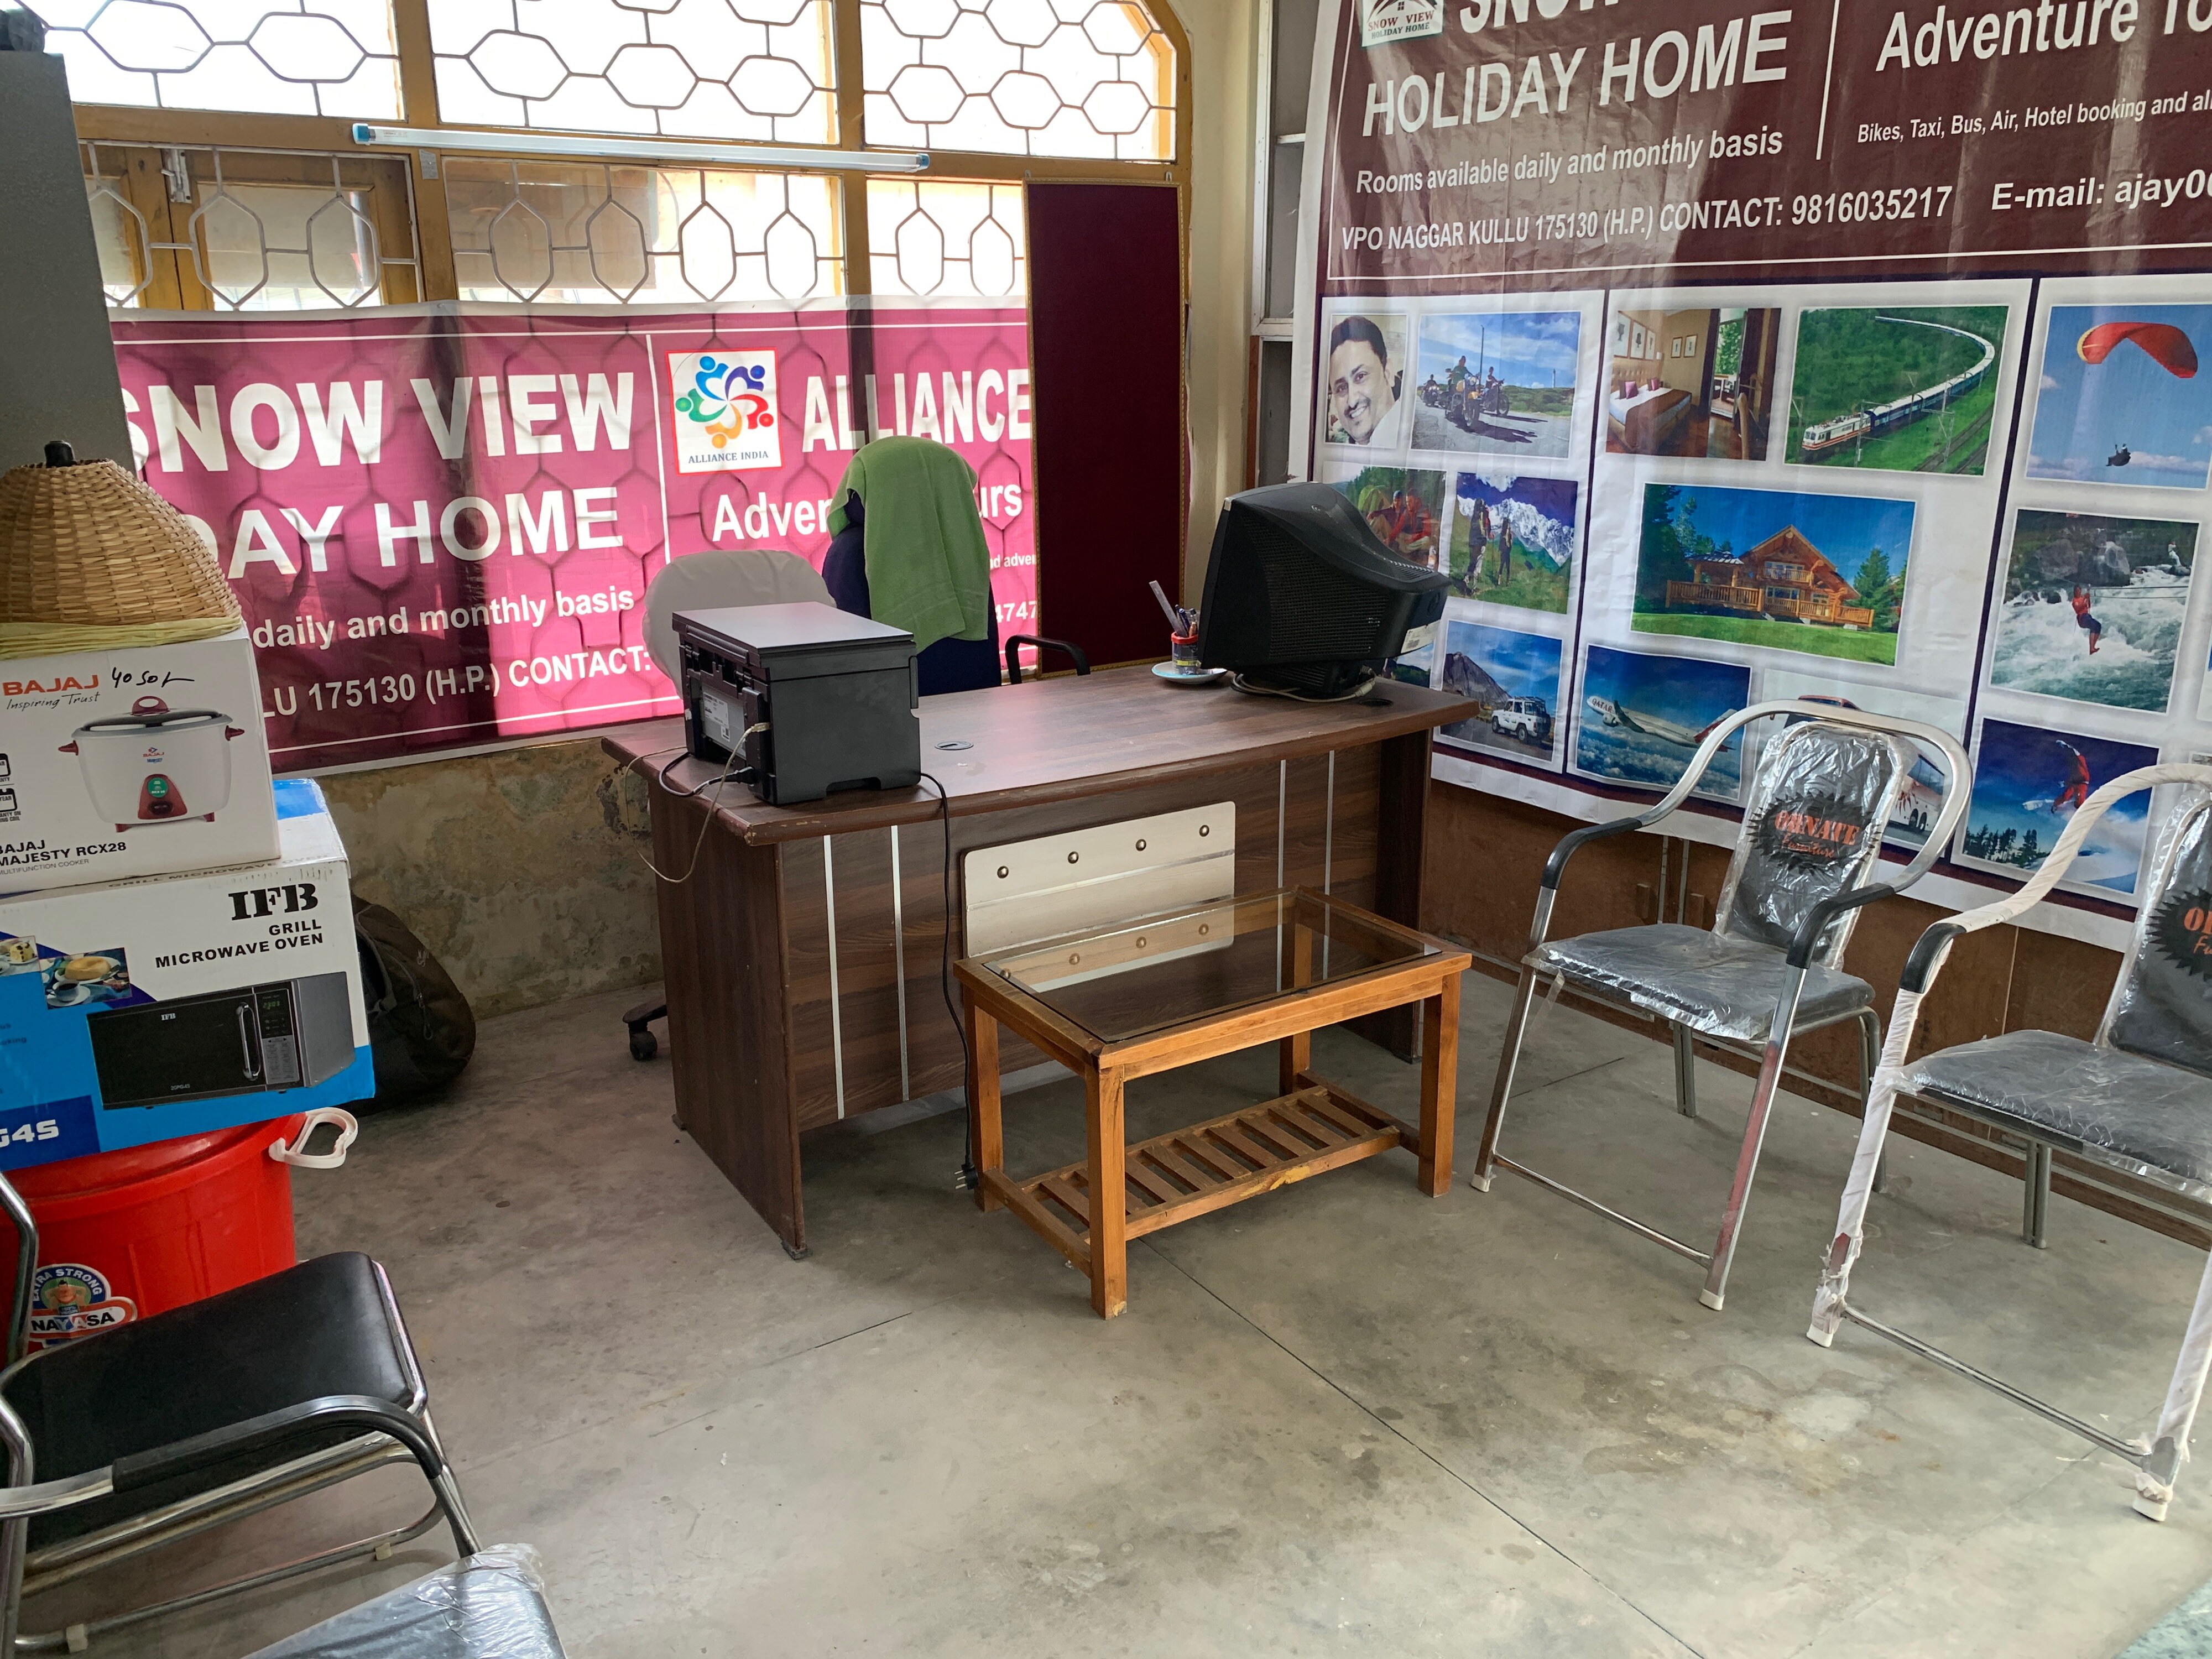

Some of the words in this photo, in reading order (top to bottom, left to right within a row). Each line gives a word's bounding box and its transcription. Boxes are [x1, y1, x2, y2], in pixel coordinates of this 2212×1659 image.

[1368, 17, 1399, 32] SNOW
[1406, 10, 1435, 24] VIEW
[1371, 27, 1404, 39] HOLIDAY
[1405, 22, 1430, 33] HOME
[1876, 0, 2138, 71] Adventure
[1363, 48, 1587, 137] HOLIDAY
[1599, 10, 1792, 106] HOME
[1858, 120, 1904, 143] Bikes,
[1910, 117, 1945, 139] Taxi,
[1951, 114, 1986, 135] Bus,
[1991, 110, 2019, 133] Air,
[2025, 103, 2073, 128] Hotel
[2077, 98, 2146, 124] booking
[2151, 91, 2188, 115] and
[1357, 170, 1422, 193] Rooms
[1427, 158, 1509, 189] available
[1515, 152, 1561, 185] daily
[1567, 145, 1606, 174] and
[1613, 134, 1703, 169] monthly
[1710, 125, 1783, 158] basis
[1991, 178, 2105, 210] E-mail:
[1342, 227, 1383, 250] VPO
[1388, 222, 1463, 249] NAGGAR
[1469, 217, 1528, 244] KULLU
[1536, 211, 1597, 241] 175130
[1604, 206, 1653, 242] (H.P.)
[1660, 197, 1783, 231] CONTACT:
[1792, 186, 1952, 226] 9816035217
[410, 372, 634, 460] VIEW
[802, 369, 1031, 453] ALLIANCE
[688, 452, 737, 464] ALLIANCE
[740, 451, 769, 461] INDIA
[374, 487, 624, 567] HOME
[253, 615, 335, 650] daily
[347, 607, 410, 640] and
[419, 593, 546, 633] monthly
[557, 585, 634, 616] basis
[2, 675, 99, 696] BAJAJ
[309, 673, 415, 711] 175130
[426, 662, 500, 706] (H.P.)
[509, 647, 651, 687] CONTACT:
[7, 698, 60, 712] Inspiring
[62, 691, 100, 705] Trust
[1592, 698, 1613, 713] QATAR
[58, 859, 89, 868] COOKER
[76, 842, 126, 857] RCX28
[169, 862, 278, 880] MICROWAVE
[228, 883, 319, 921] IFB
[269, 919, 322, 936] GRILL
[155, 941, 270, 968] MICROWAVE
[275, 933, 323, 950] OVEN
[56, 1269, 102, 1295] STRONG
[32, 1312, 115, 1331] NAYASA
